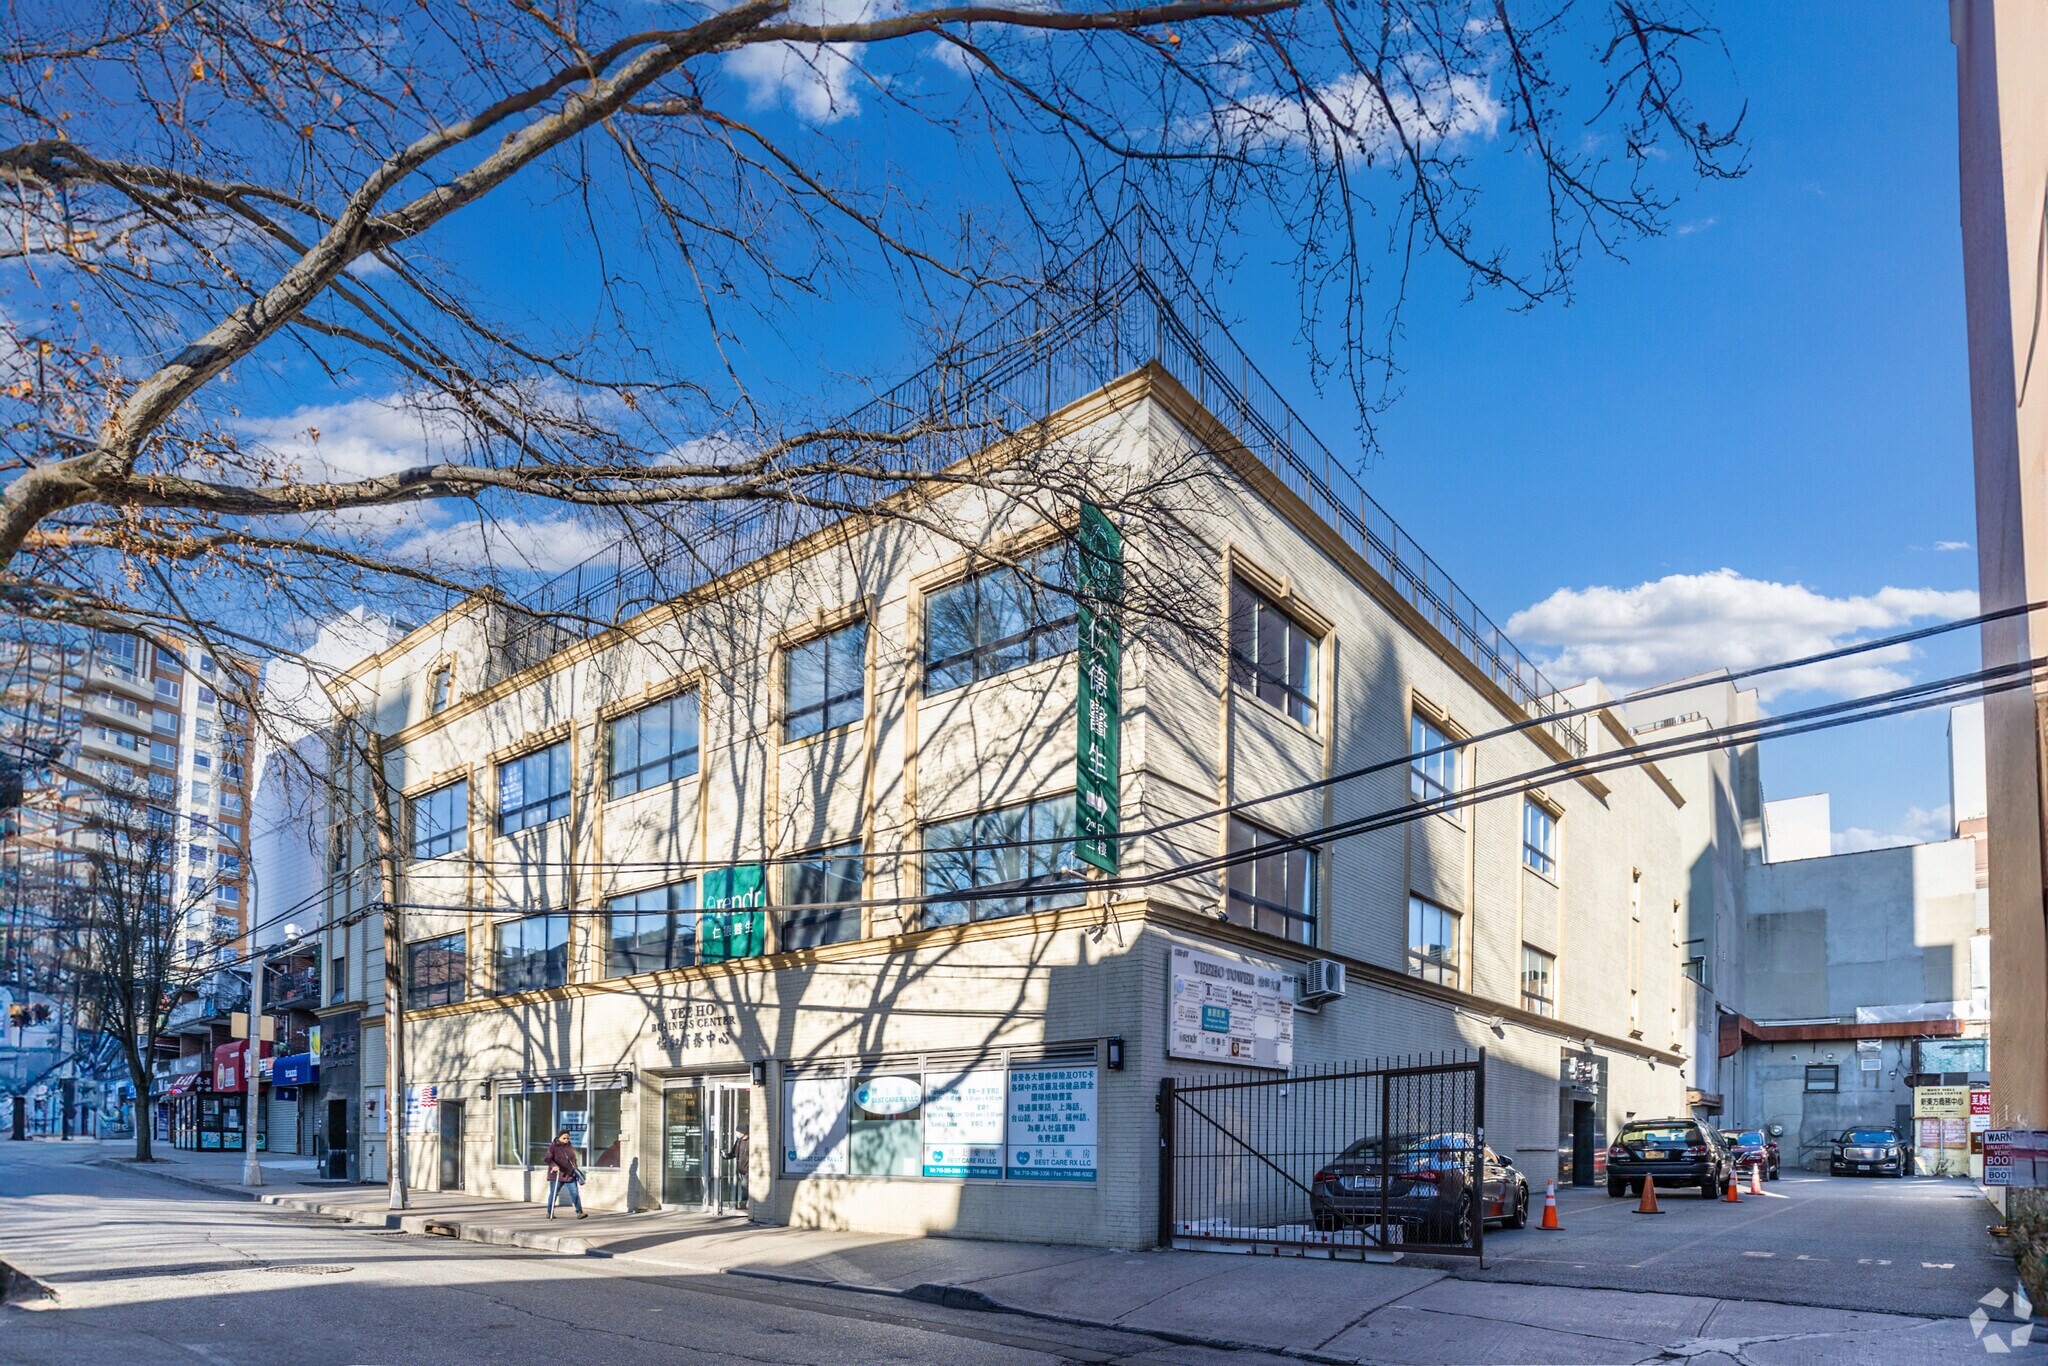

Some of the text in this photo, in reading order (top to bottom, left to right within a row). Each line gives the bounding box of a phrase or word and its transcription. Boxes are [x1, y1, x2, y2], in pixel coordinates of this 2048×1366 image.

[1194, 960, 1255, 986] YEEHO TOWER
[670, 1004, 715, 1020] YEE HO
[652, 1016, 736, 1032] BUSINESS CENTER
[1036, 1149, 1090, 1158] 博士藥房
